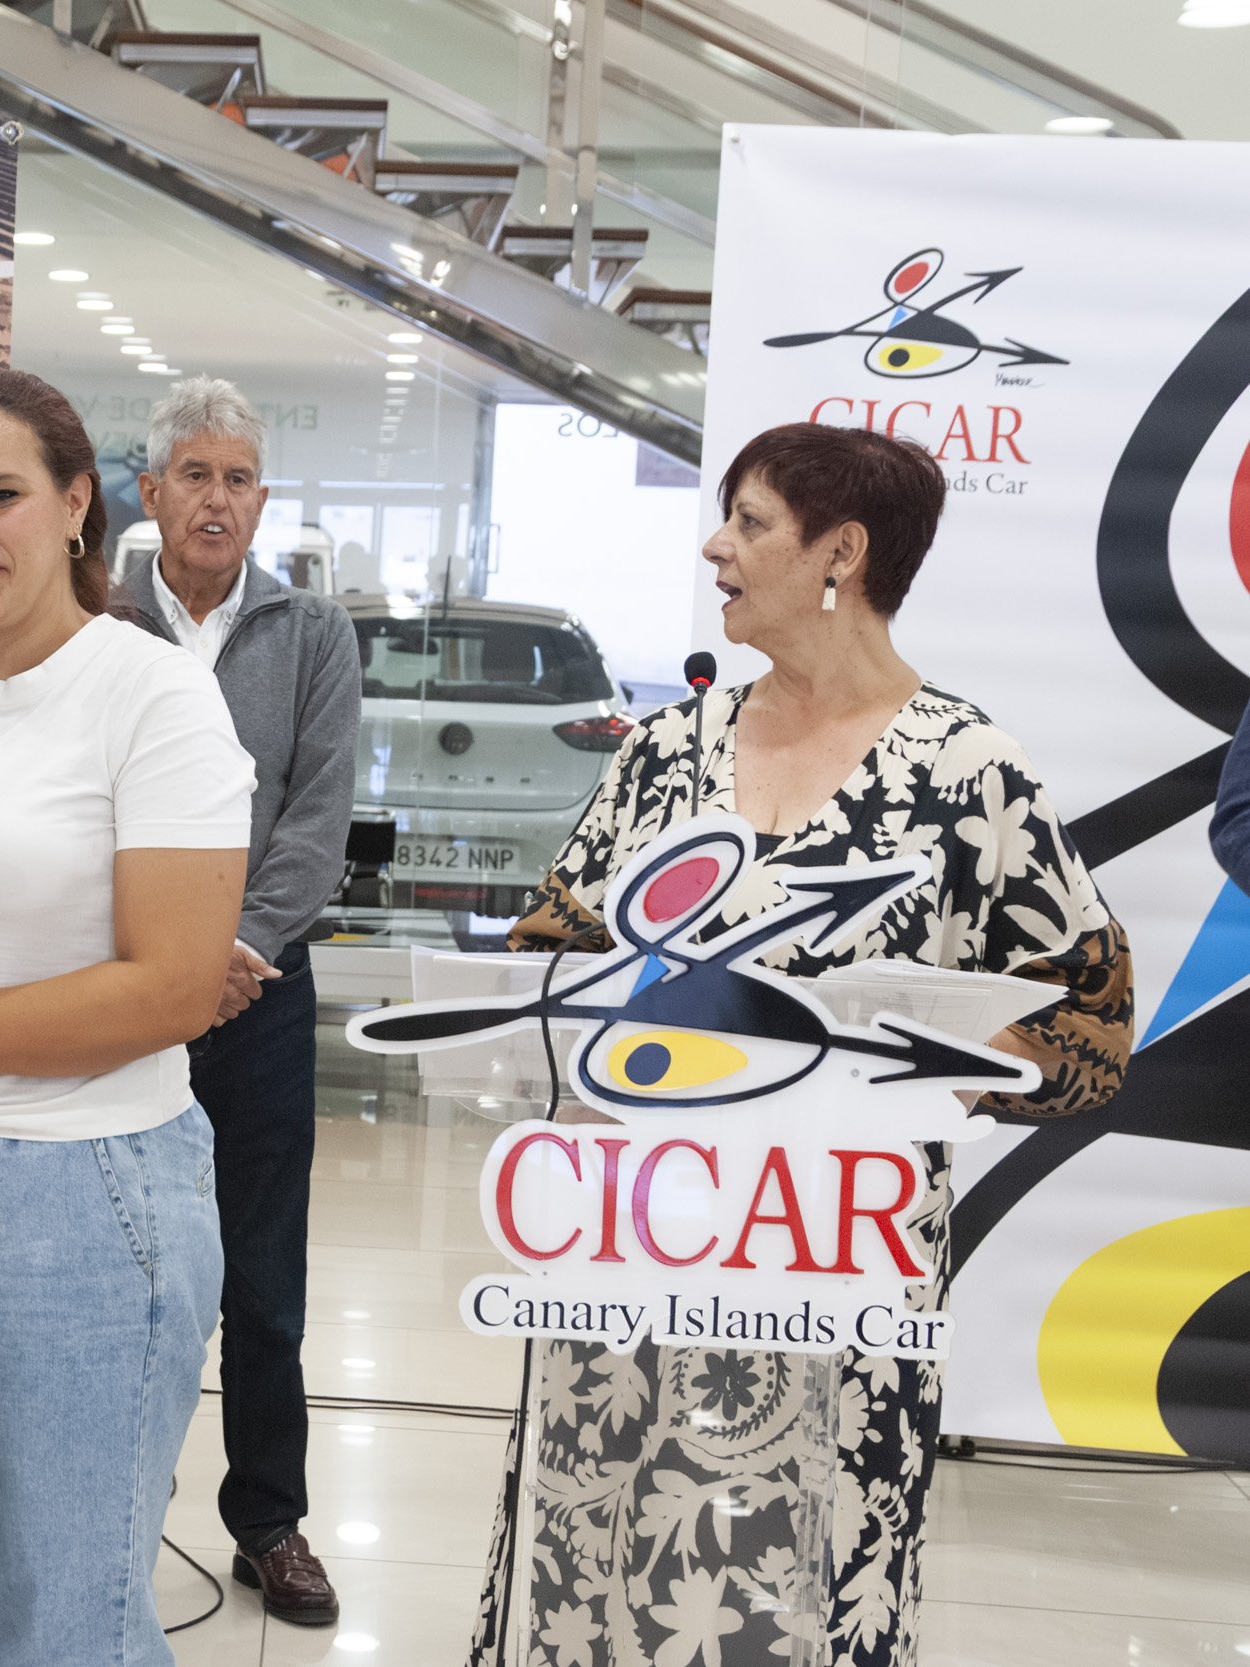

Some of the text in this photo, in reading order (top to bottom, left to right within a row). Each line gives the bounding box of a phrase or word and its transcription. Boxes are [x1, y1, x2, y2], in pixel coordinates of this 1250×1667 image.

[985, 472, 1029, 495] Car
[396, 844, 515, 871] 8342 NNP
[495, 1132, 926, 1278] CICAR
[472, 1284, 946, 1351] Canary Islands Car
